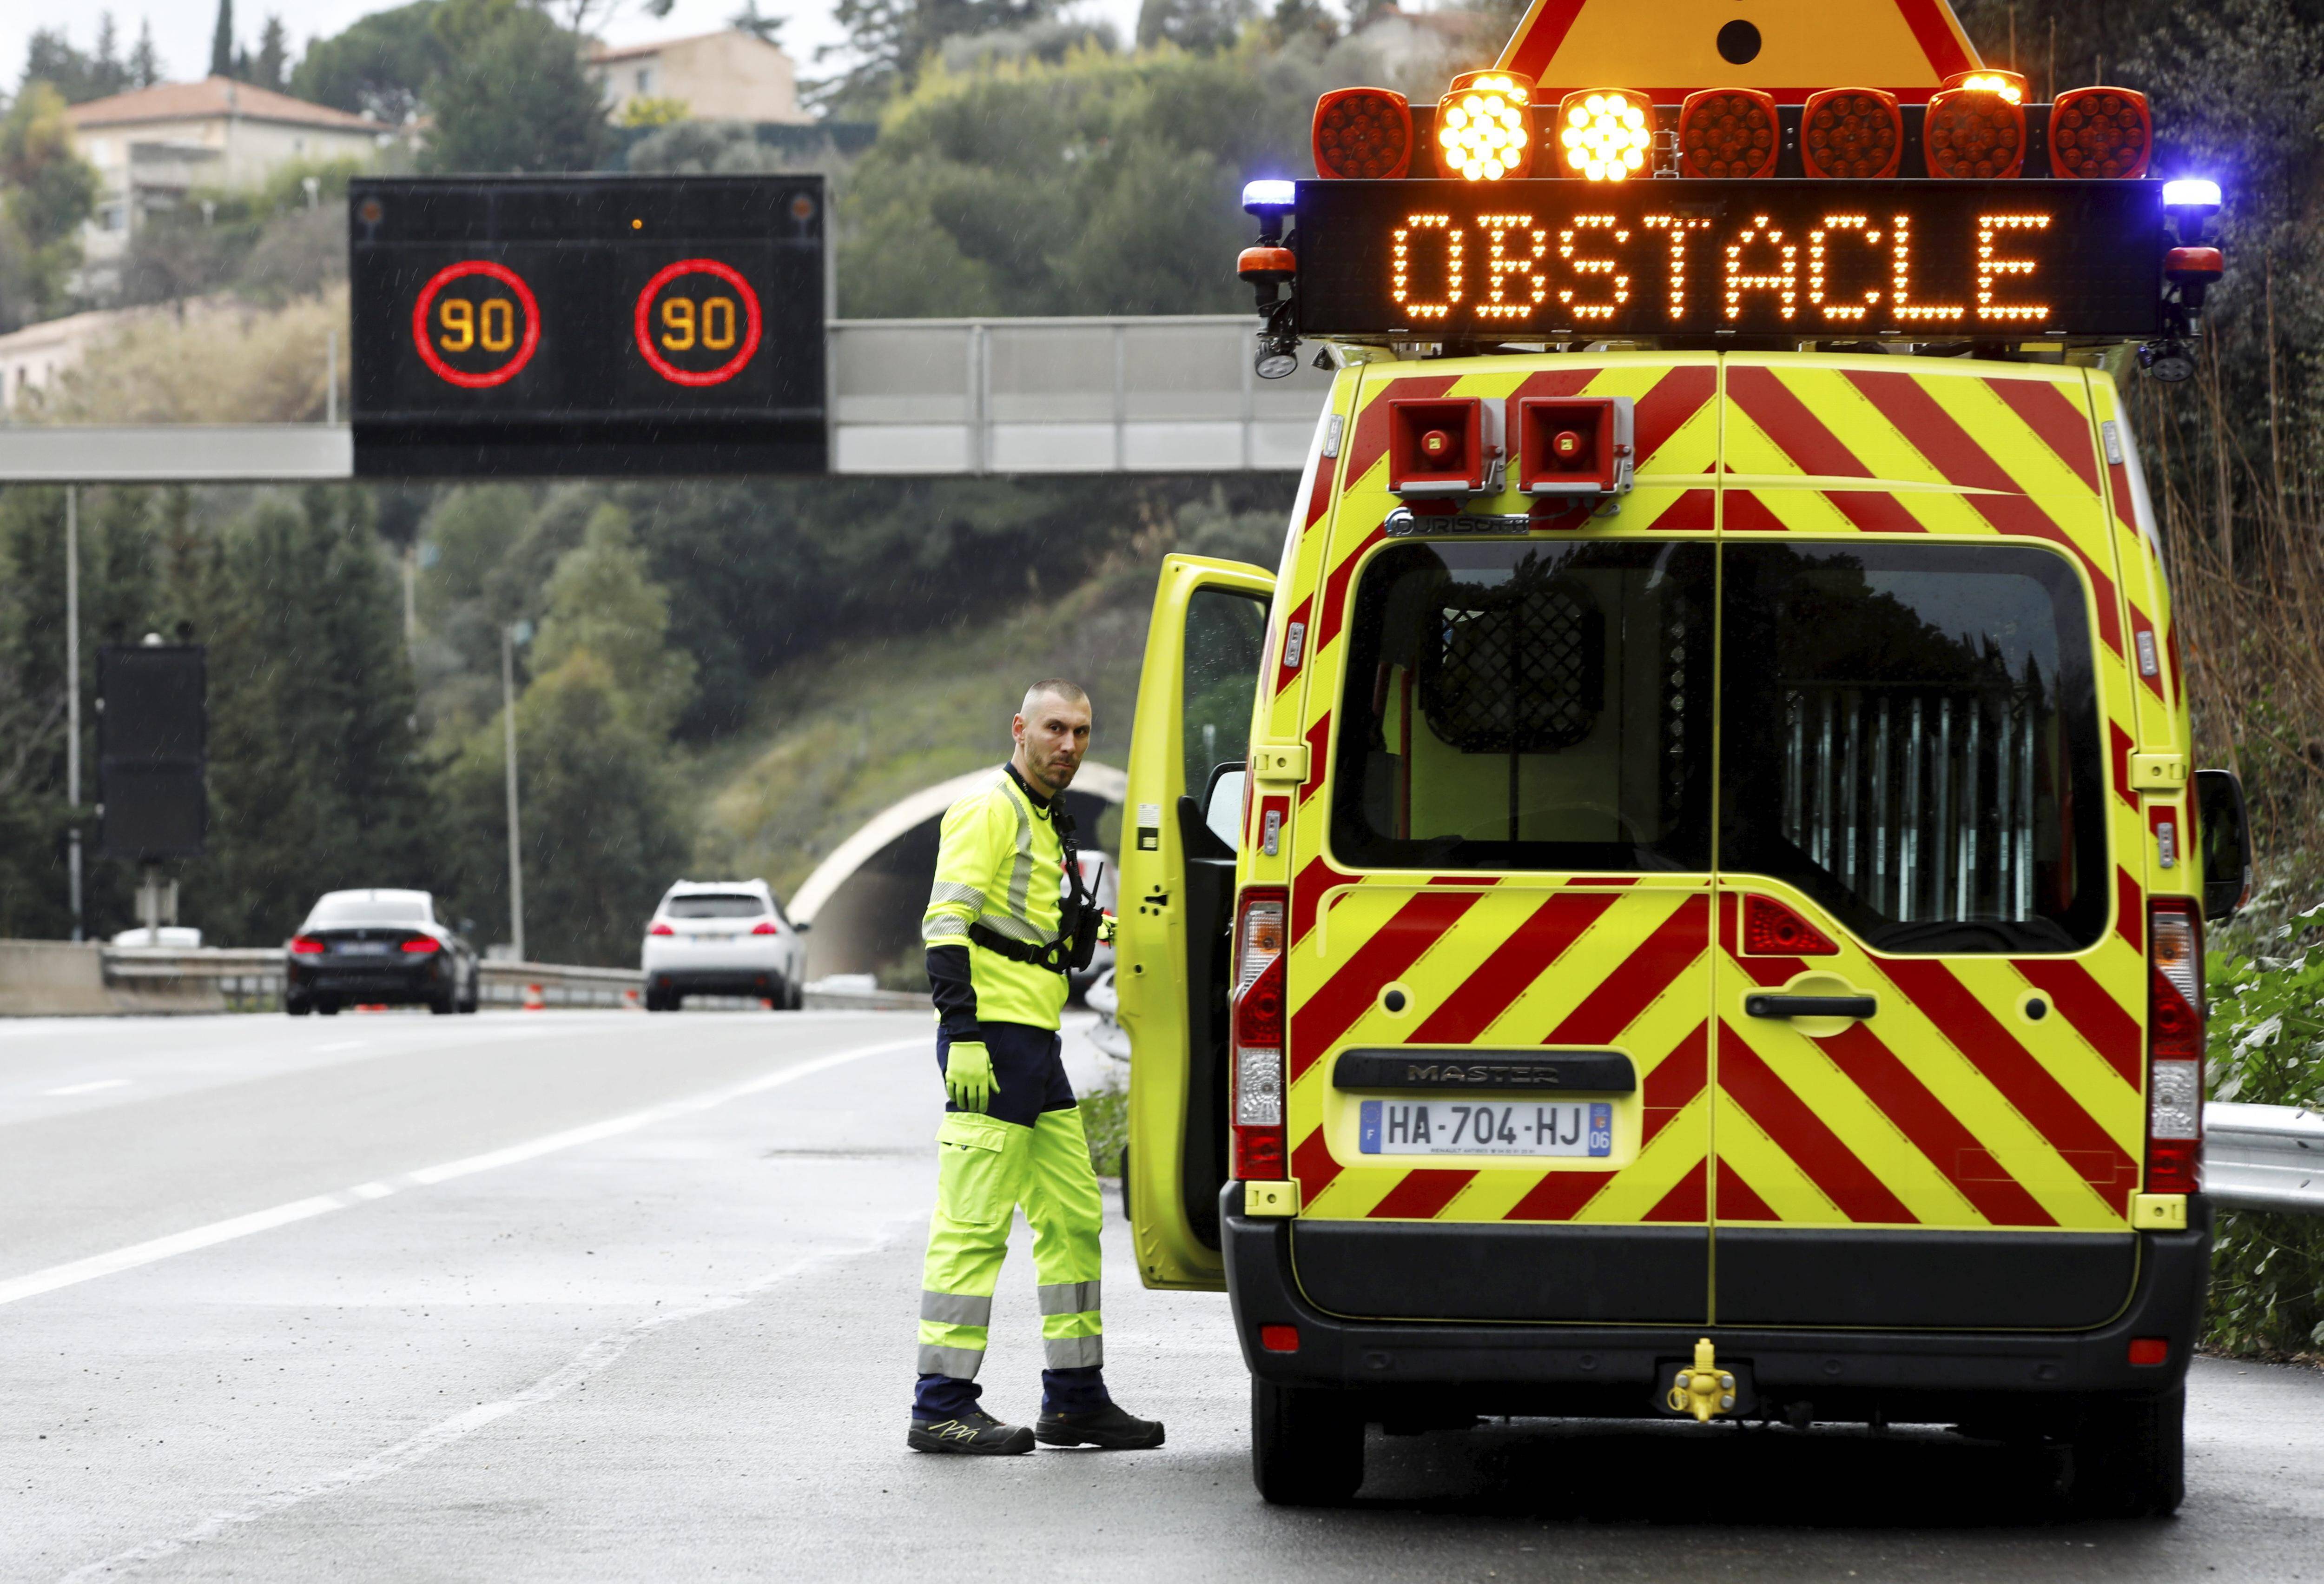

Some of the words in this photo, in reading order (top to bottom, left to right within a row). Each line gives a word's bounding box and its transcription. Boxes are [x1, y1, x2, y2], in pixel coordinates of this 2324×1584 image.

[1393, 215, 2050, 318] OBSTACLE
[440, 298, 514, 352] 90
[662, 297, 735, 350] 90
[1408, 1065, 1559, 1084] MASTER
[1367, 1129, 1374, 1140] F
[1389, 1106, 1580, 1145] HA-704-HJ
[1590, 1131, 1610, 1149] 06
